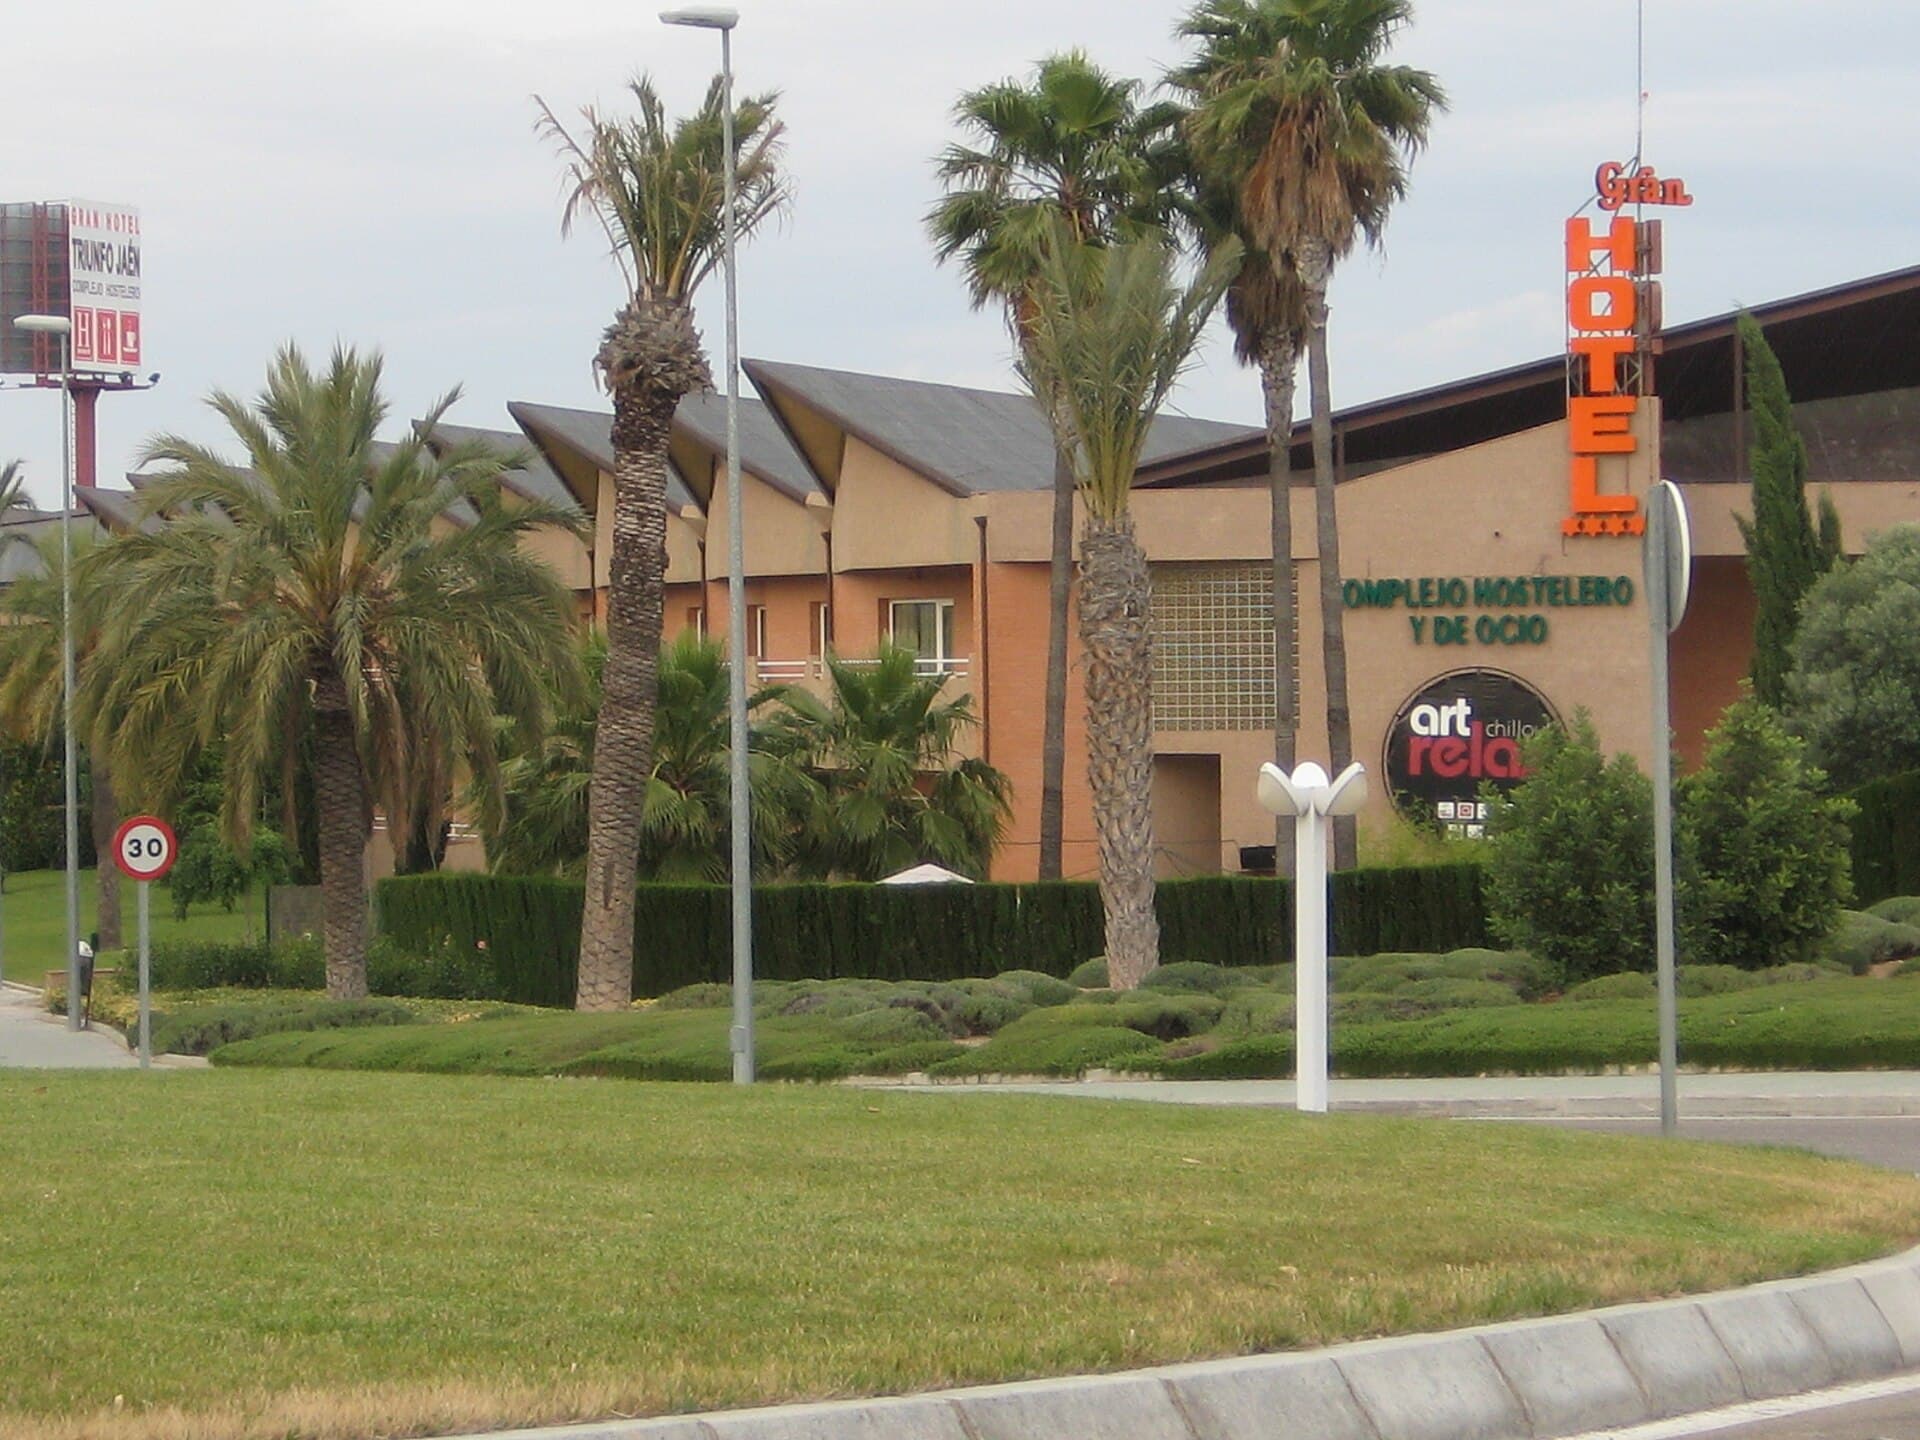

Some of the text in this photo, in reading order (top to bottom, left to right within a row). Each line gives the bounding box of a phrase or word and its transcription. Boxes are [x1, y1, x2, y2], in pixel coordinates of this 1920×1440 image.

[1596, 162, 1693, 210] Gran
[72, 207, 140, 235] GRAN HOTEL
[72, 238, 140, 277] TRIUNFO JAÉN
[1566, 216, 1638, 513] HOTEL
[1343, 576, 1633, 608] OMPLEJO HOSTELERO
[1409, 614, 1547, 645] Y DE OCIO
[1410, 698, 1471, 737] art
[1408, 721, 1537, 778] rela
[128, 838, 162, 858] 30
